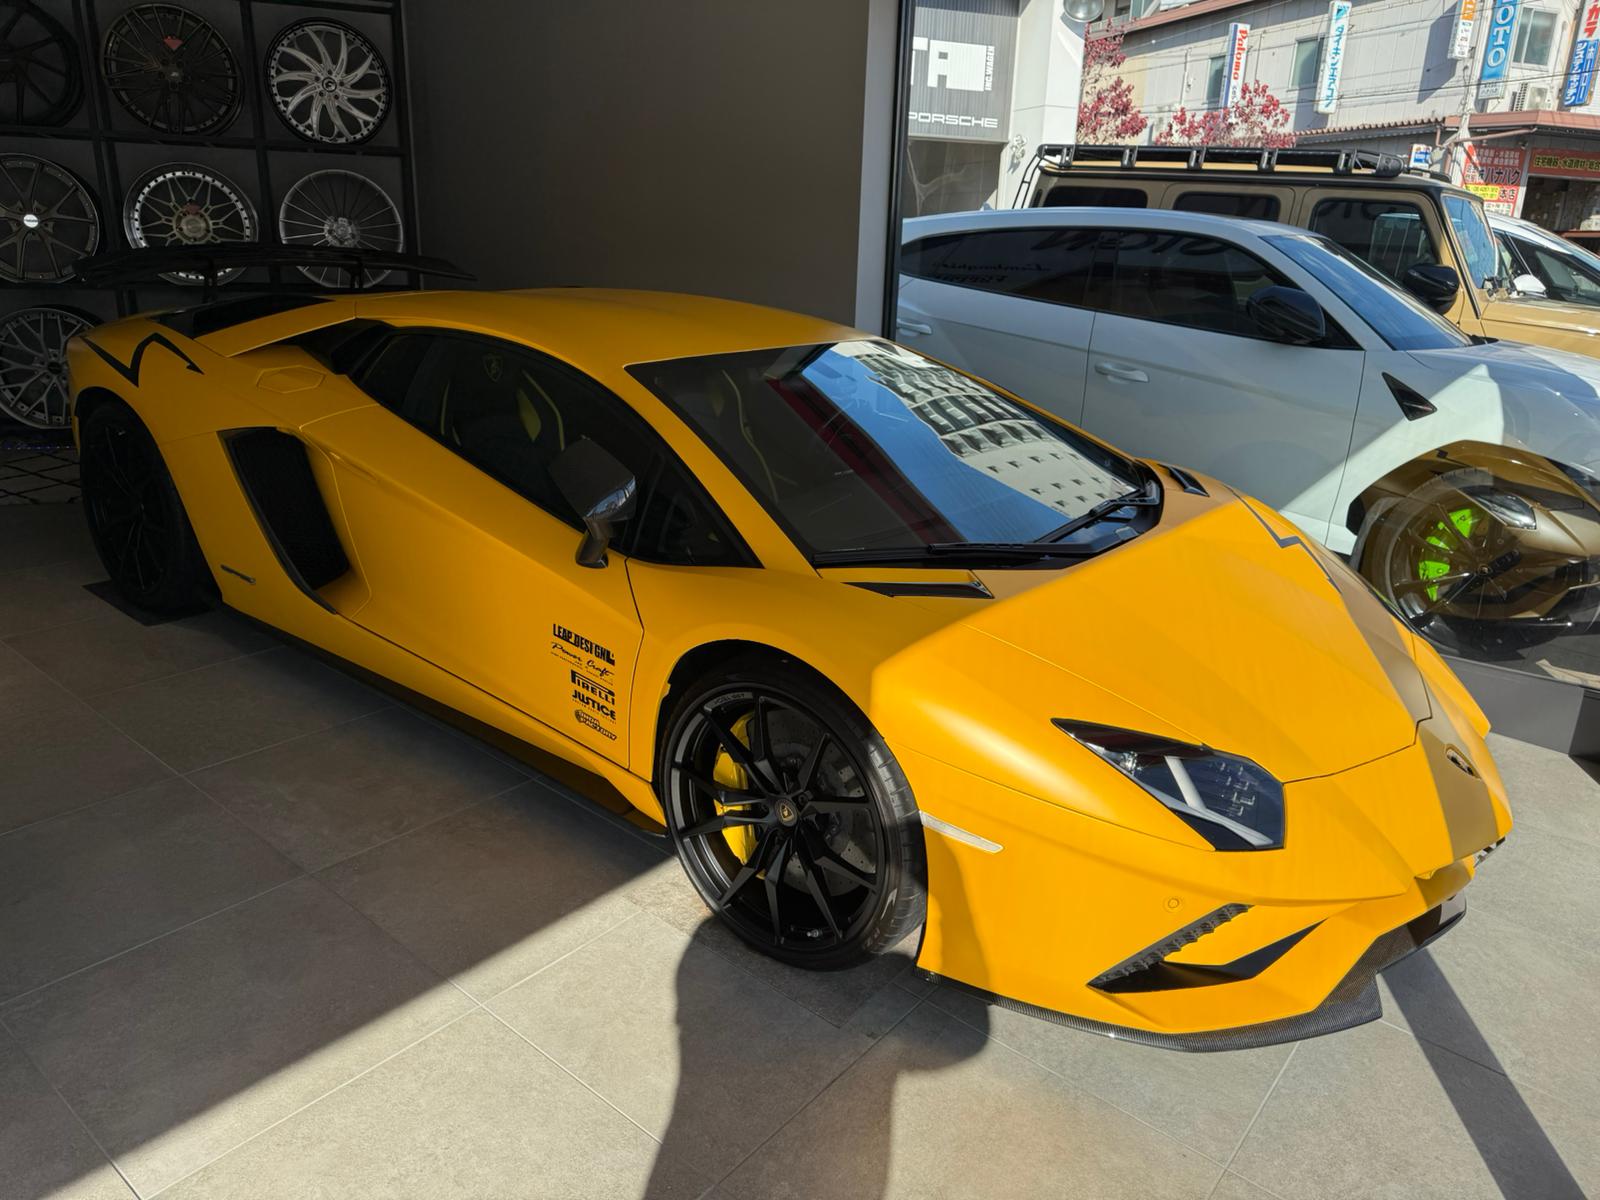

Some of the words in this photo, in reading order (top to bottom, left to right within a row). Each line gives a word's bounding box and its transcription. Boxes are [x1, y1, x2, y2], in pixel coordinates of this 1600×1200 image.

[1233, 29, 1248, 81] Paloma
[1325, 25, 1345, 108] ダイキンエアコン
[908, 111, 999, 128] PORSCHE
[1499, 187, 1516, 200] 本店
[570, 669, 616, 705] PIRELLI
[571, 690, 617, 720] JUSTICE
